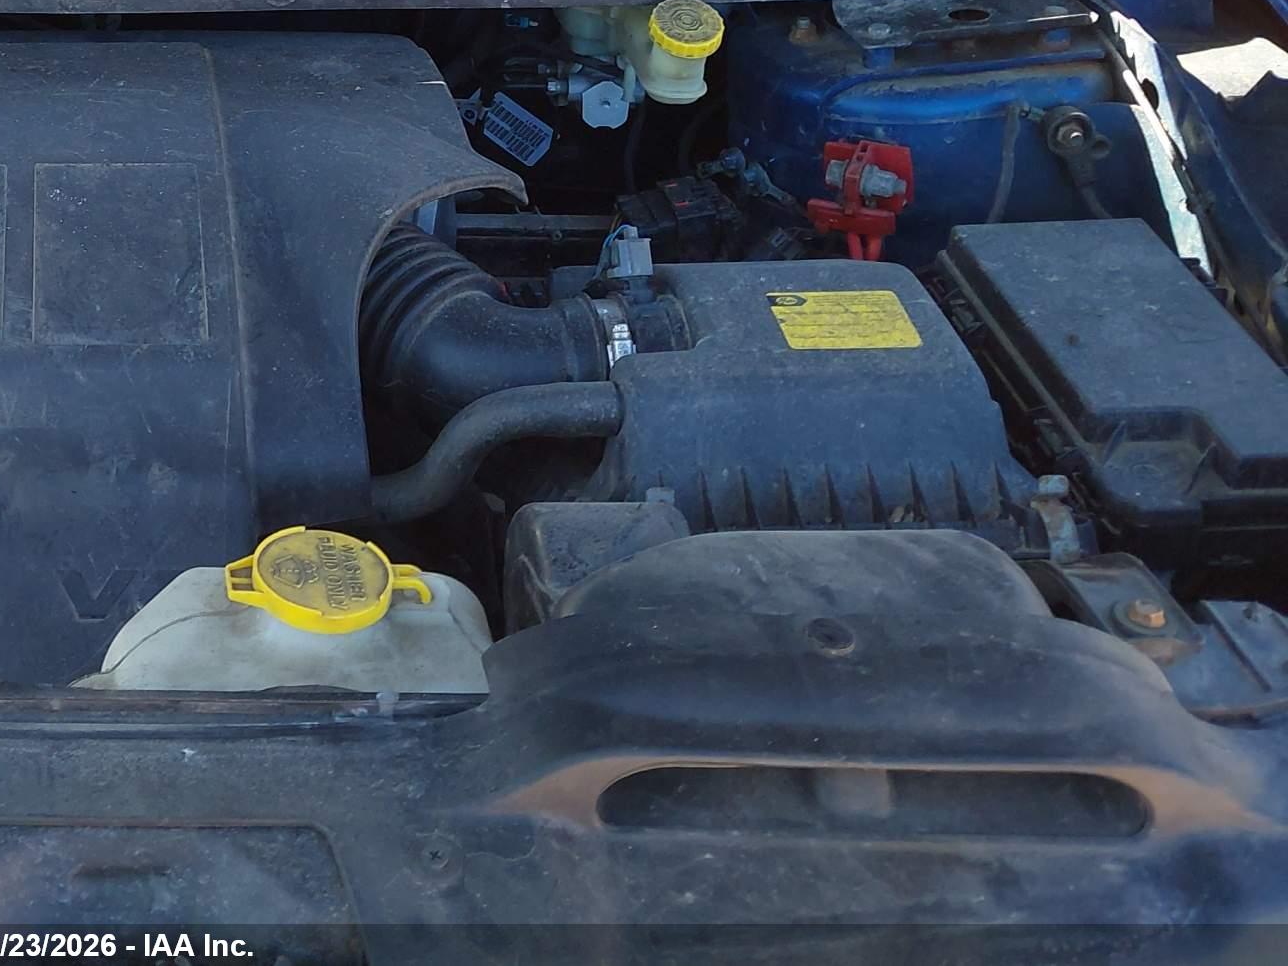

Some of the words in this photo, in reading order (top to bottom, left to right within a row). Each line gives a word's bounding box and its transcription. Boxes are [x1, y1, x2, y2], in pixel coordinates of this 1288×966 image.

[317, 536, 338, 572] FLUID
[341, 543, 368, 603] WASHER
[325, 574, 351, 611] ONLY
